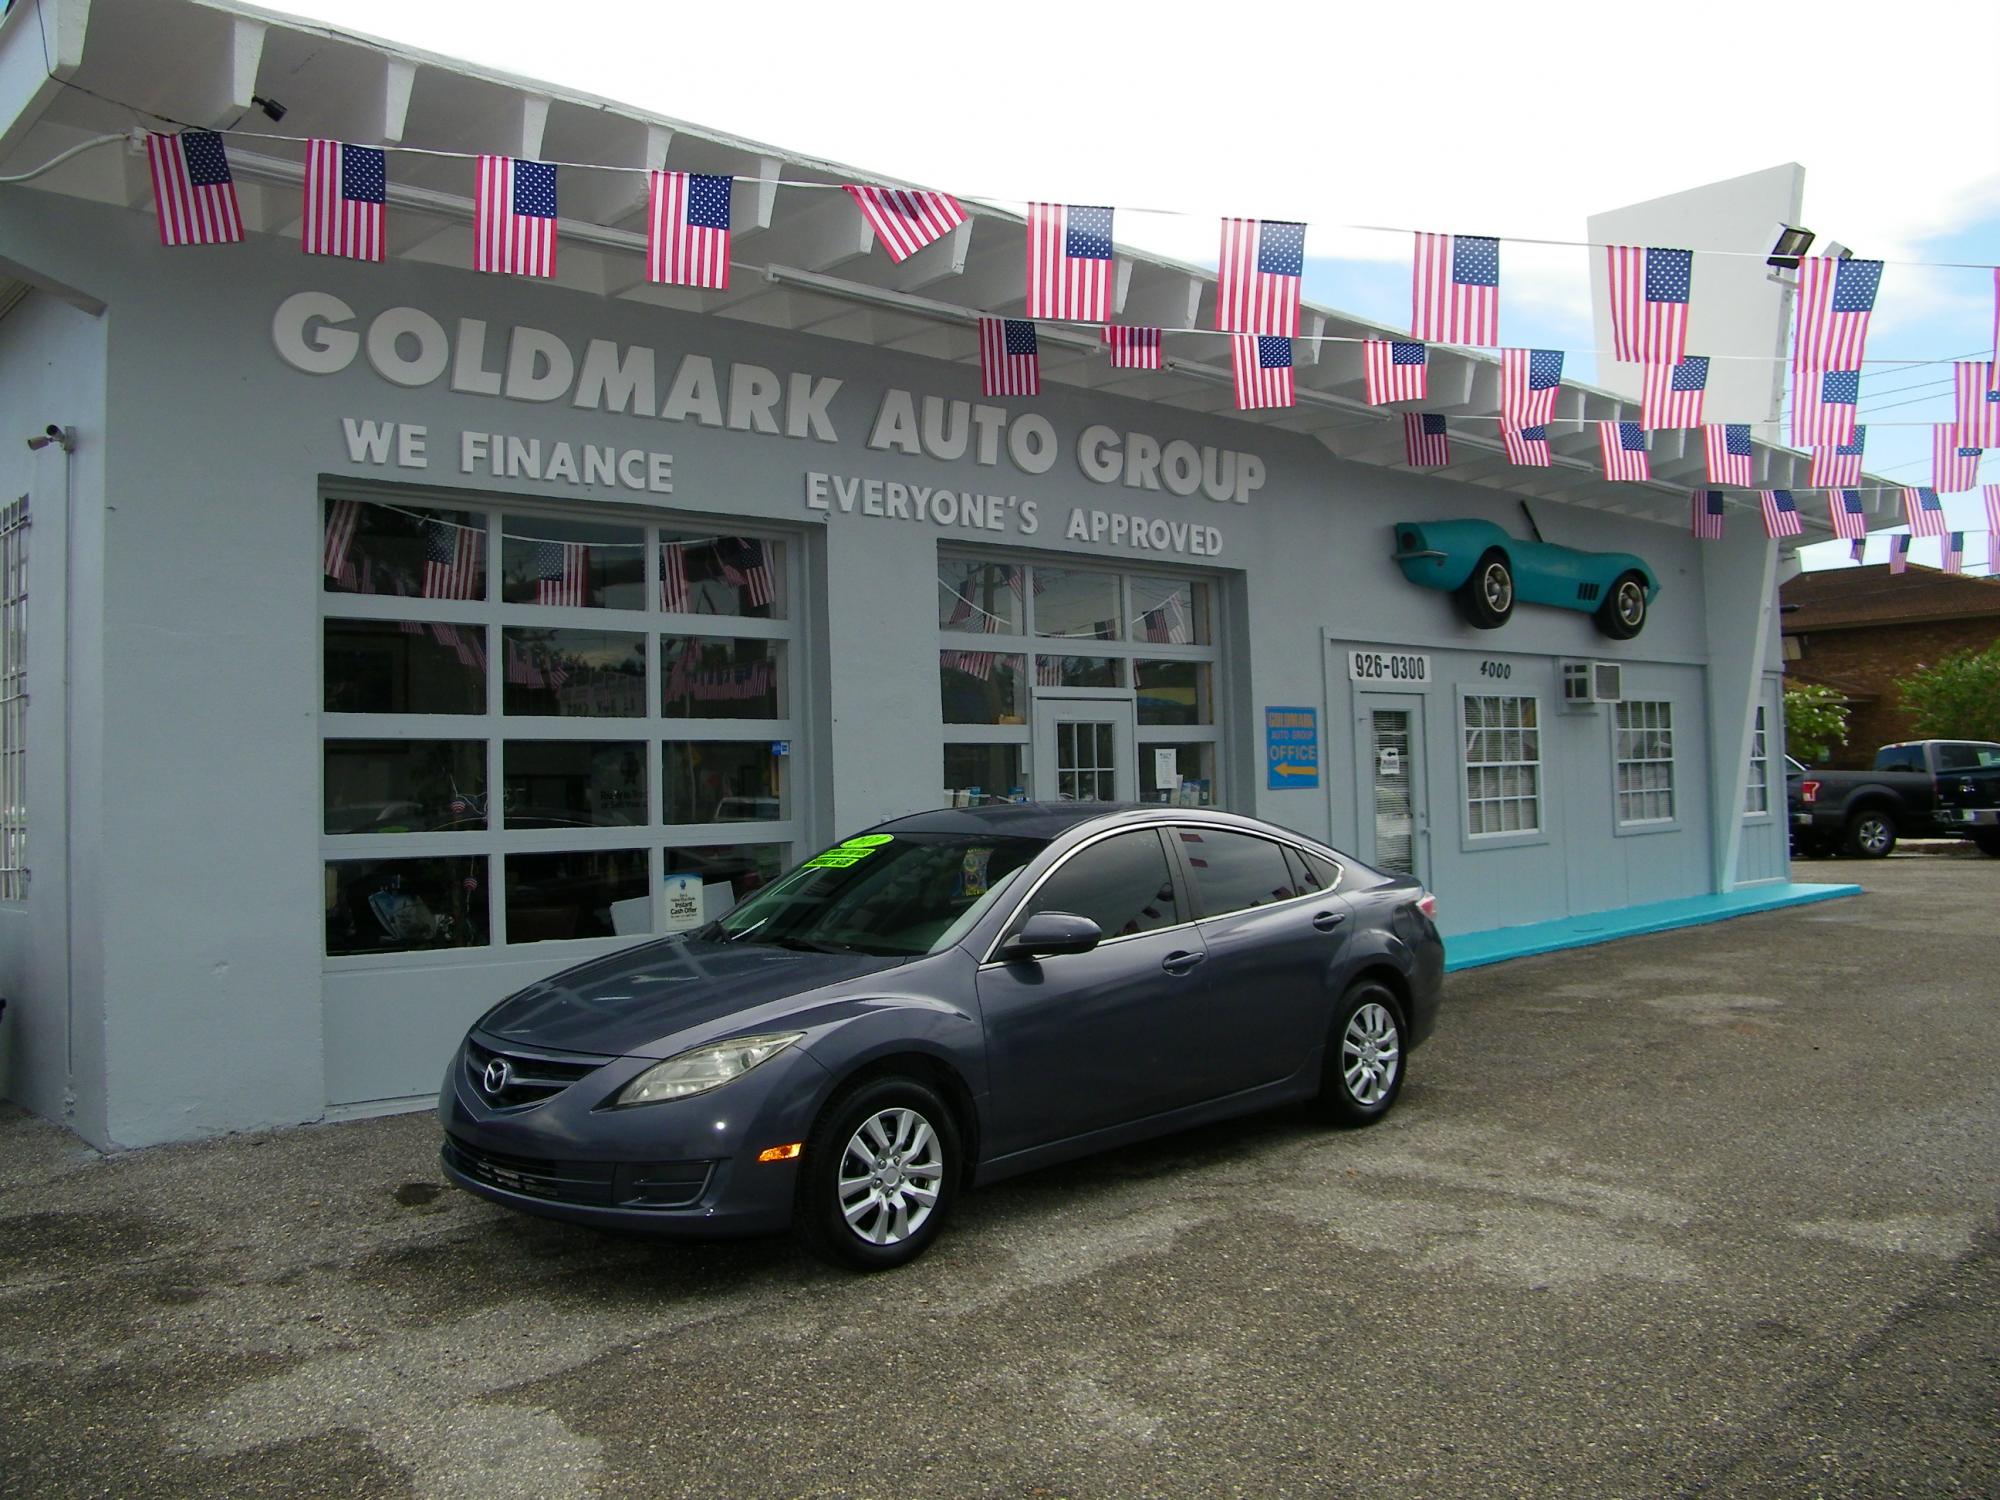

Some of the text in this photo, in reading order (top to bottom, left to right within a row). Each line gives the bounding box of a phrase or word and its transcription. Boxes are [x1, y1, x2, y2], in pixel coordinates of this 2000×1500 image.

[271, 291, 1267, 504] GOLDMARK AUTO GROUP
[341, 417, 674, 494] WE FINANCE
[805, 471, 1223, 557] EVERYONE'S APPROVED
[1355, 652, 1425, 680] 926-0300
[1480, 660, 1511, 680] 4000
[1270, 745, 1317, 760] OFFICE
